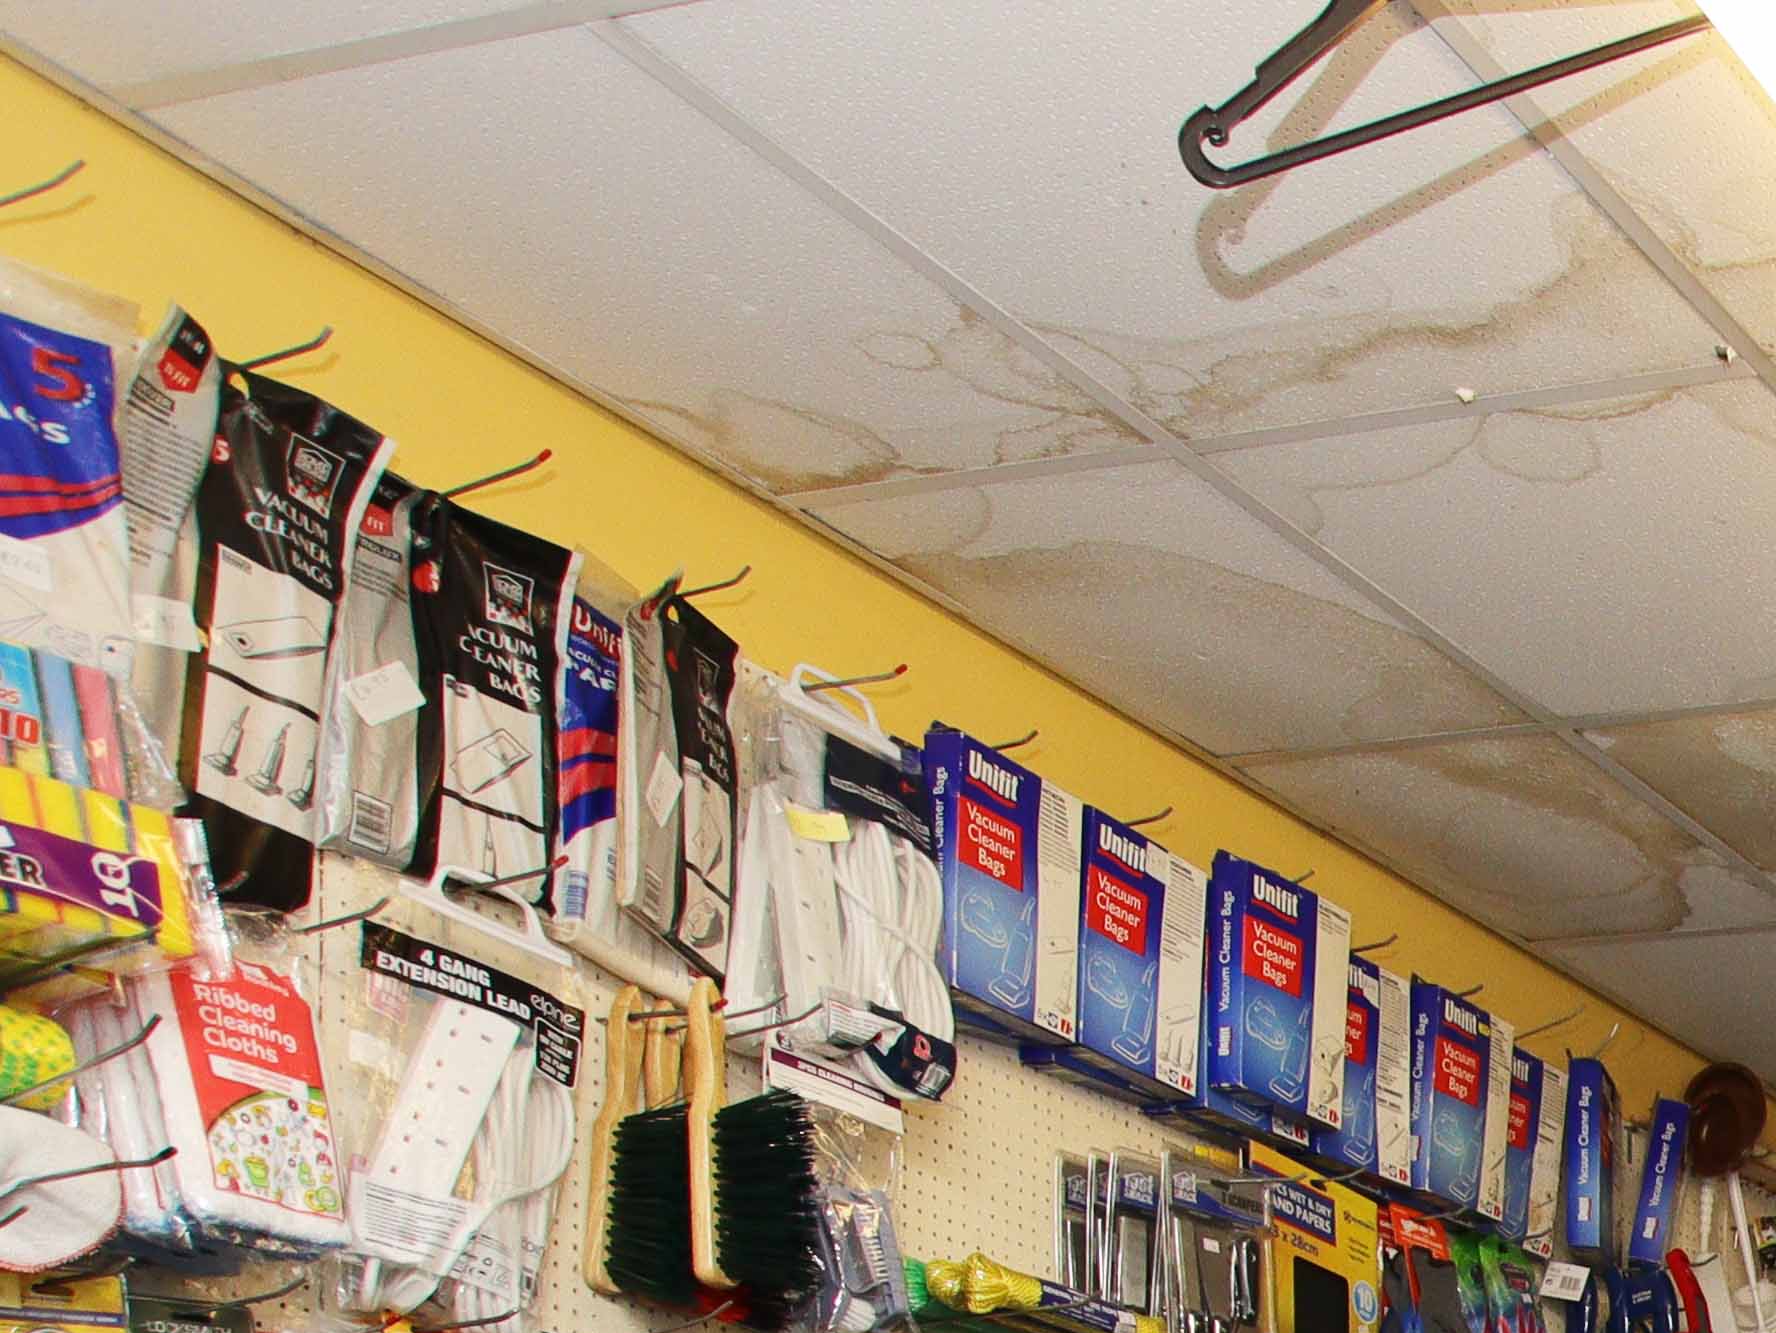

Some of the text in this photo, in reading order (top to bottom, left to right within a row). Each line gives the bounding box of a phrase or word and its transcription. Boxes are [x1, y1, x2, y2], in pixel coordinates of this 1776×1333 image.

[968, 749, 1019, 803] Unifit
[966, 801, 1016, 844] Vacuum
[967, 825, 1016, 861] Cleaner
[978, 847, 1006, 877] Bags
[1097, 871, 1142, 909] Vacuum
[1253, 873, 1299, 918] Unifit
[1096, 891, 1141, 928] Cleaner
[1104, 913, 1130, 942] Bags
[1219, 890, 1233, 1013] Vacuum Cleaner Bags
[1253, 920, 1298, 954] Vacuum
[419, 948, 491, 987] 4 GANG
[1252, 940, 1297, 973] Cleaner
[1262, 960, 1288, 987] Bags
[193, 984, 276, 1024] Ribbed
[375, 950, 532, 1022] EXTENSION LEAD
[198, 1005, 298, 1054] Cleaning
[203, 1027, 278, 1065] Cloths
[1441, 1058, 1476, 1083] Cleaner
[1442, 1041, 1478, 1068] Vacuum
[1448, 1075, 1469, 1099] Bags
